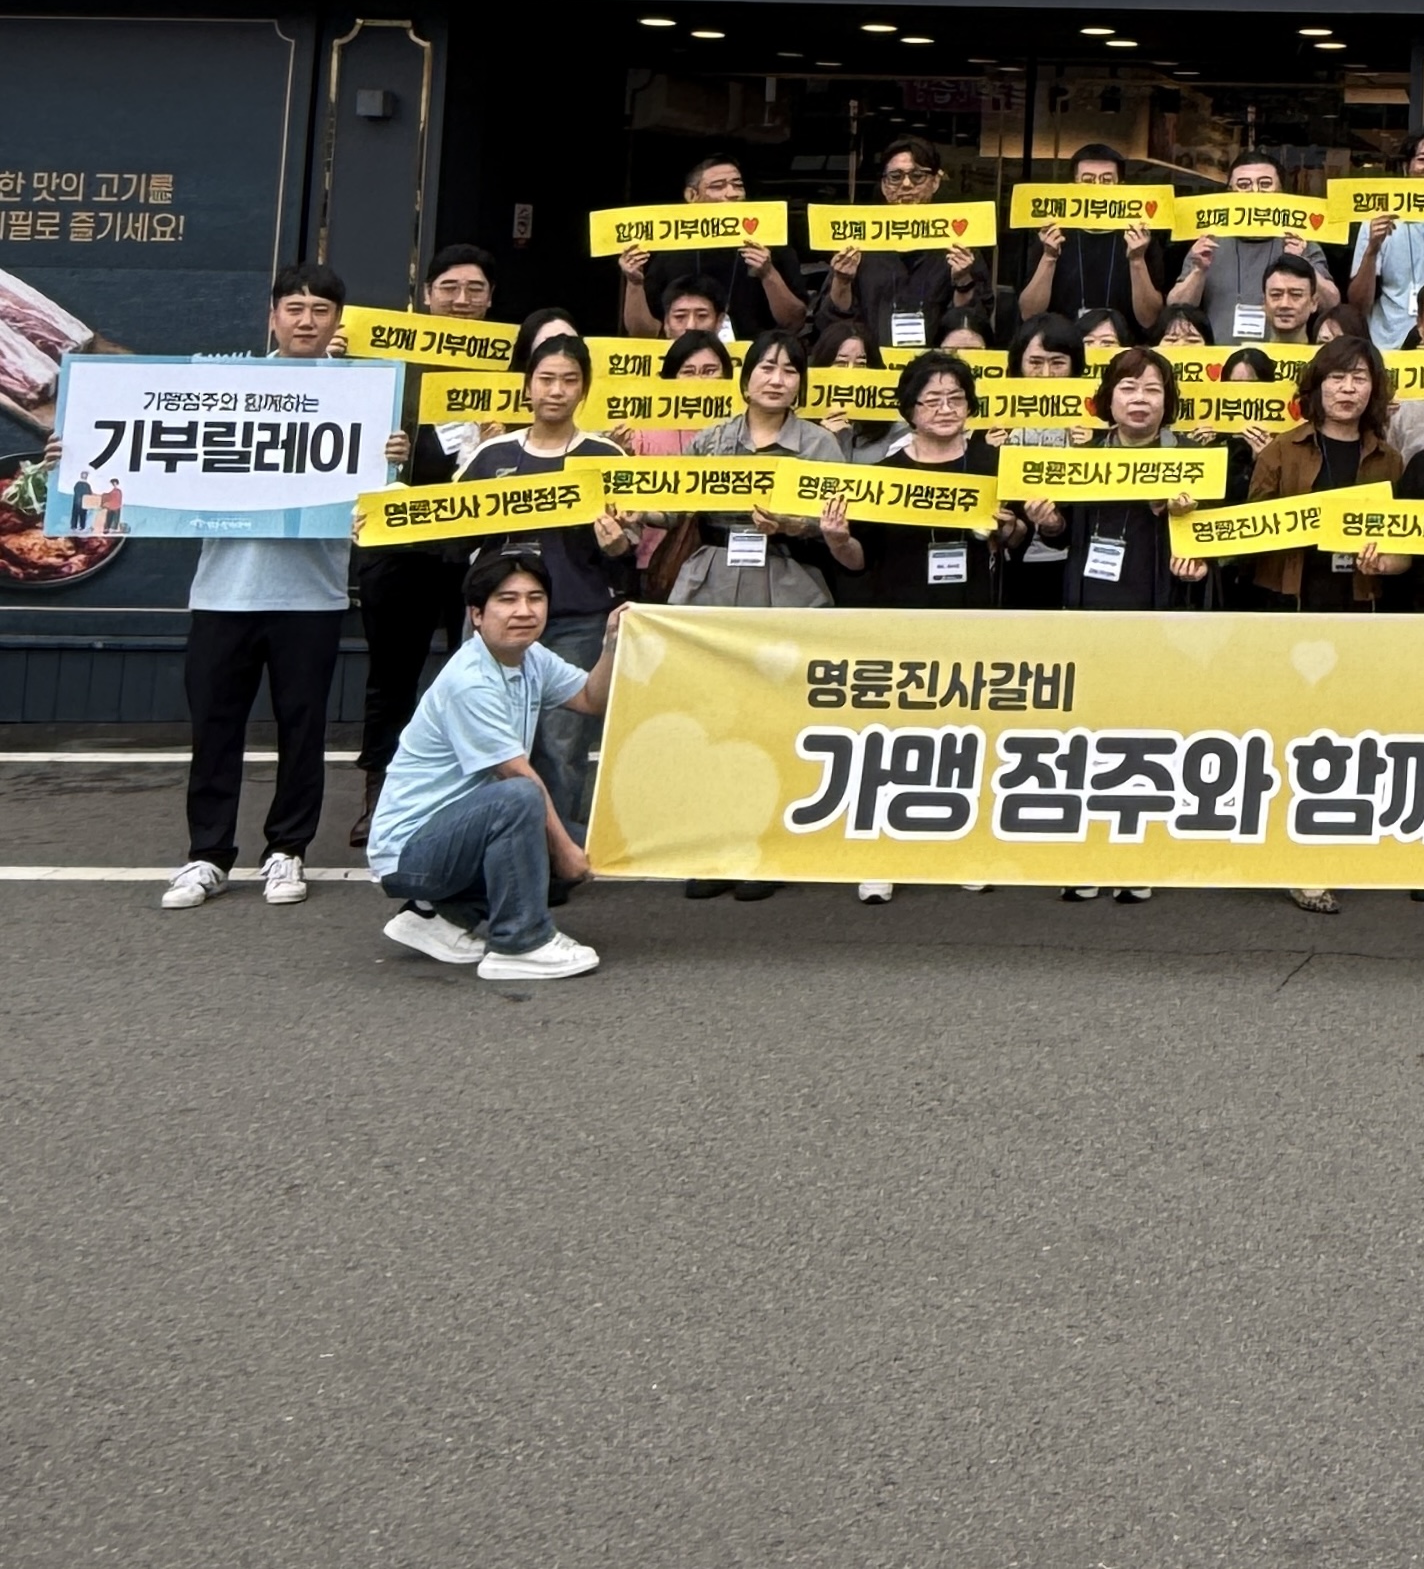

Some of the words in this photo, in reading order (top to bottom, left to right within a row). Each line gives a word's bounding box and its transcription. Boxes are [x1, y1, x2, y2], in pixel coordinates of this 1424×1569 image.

[33, 173, 85, 203] 맛의
[92, 174, 174, 205] 고기를
[69, 213, 185, 243] 즐기세요!
[370, 325, 417, 350] 함께
[421, 331, 513, 361] 기부해요
[609, 353, 651, 377] 함께
[143, 391, 238, 412] 가맹점주와
[446, 388, 491, 412] 함께
[607, 395, 651, 420] 함께
[995, 394, 1082, 418] 기부해요
[1200, 397, 1285, 422] 기부해요
[88, 419, 362, 474] 기부릴레이
[685, 471, 776, 496] 가맹점주
[1116, 462, 1204, 484] 가맹점주
[485, 484, 582, 516] 가맹점주
[888, 483, 980, 511] 가맹점주
[806, 658, 1075, 713] 명륜진사갈비
[792, 732, 977, 834] 가맹
[1002, 733, 1273, 837] 점주와
